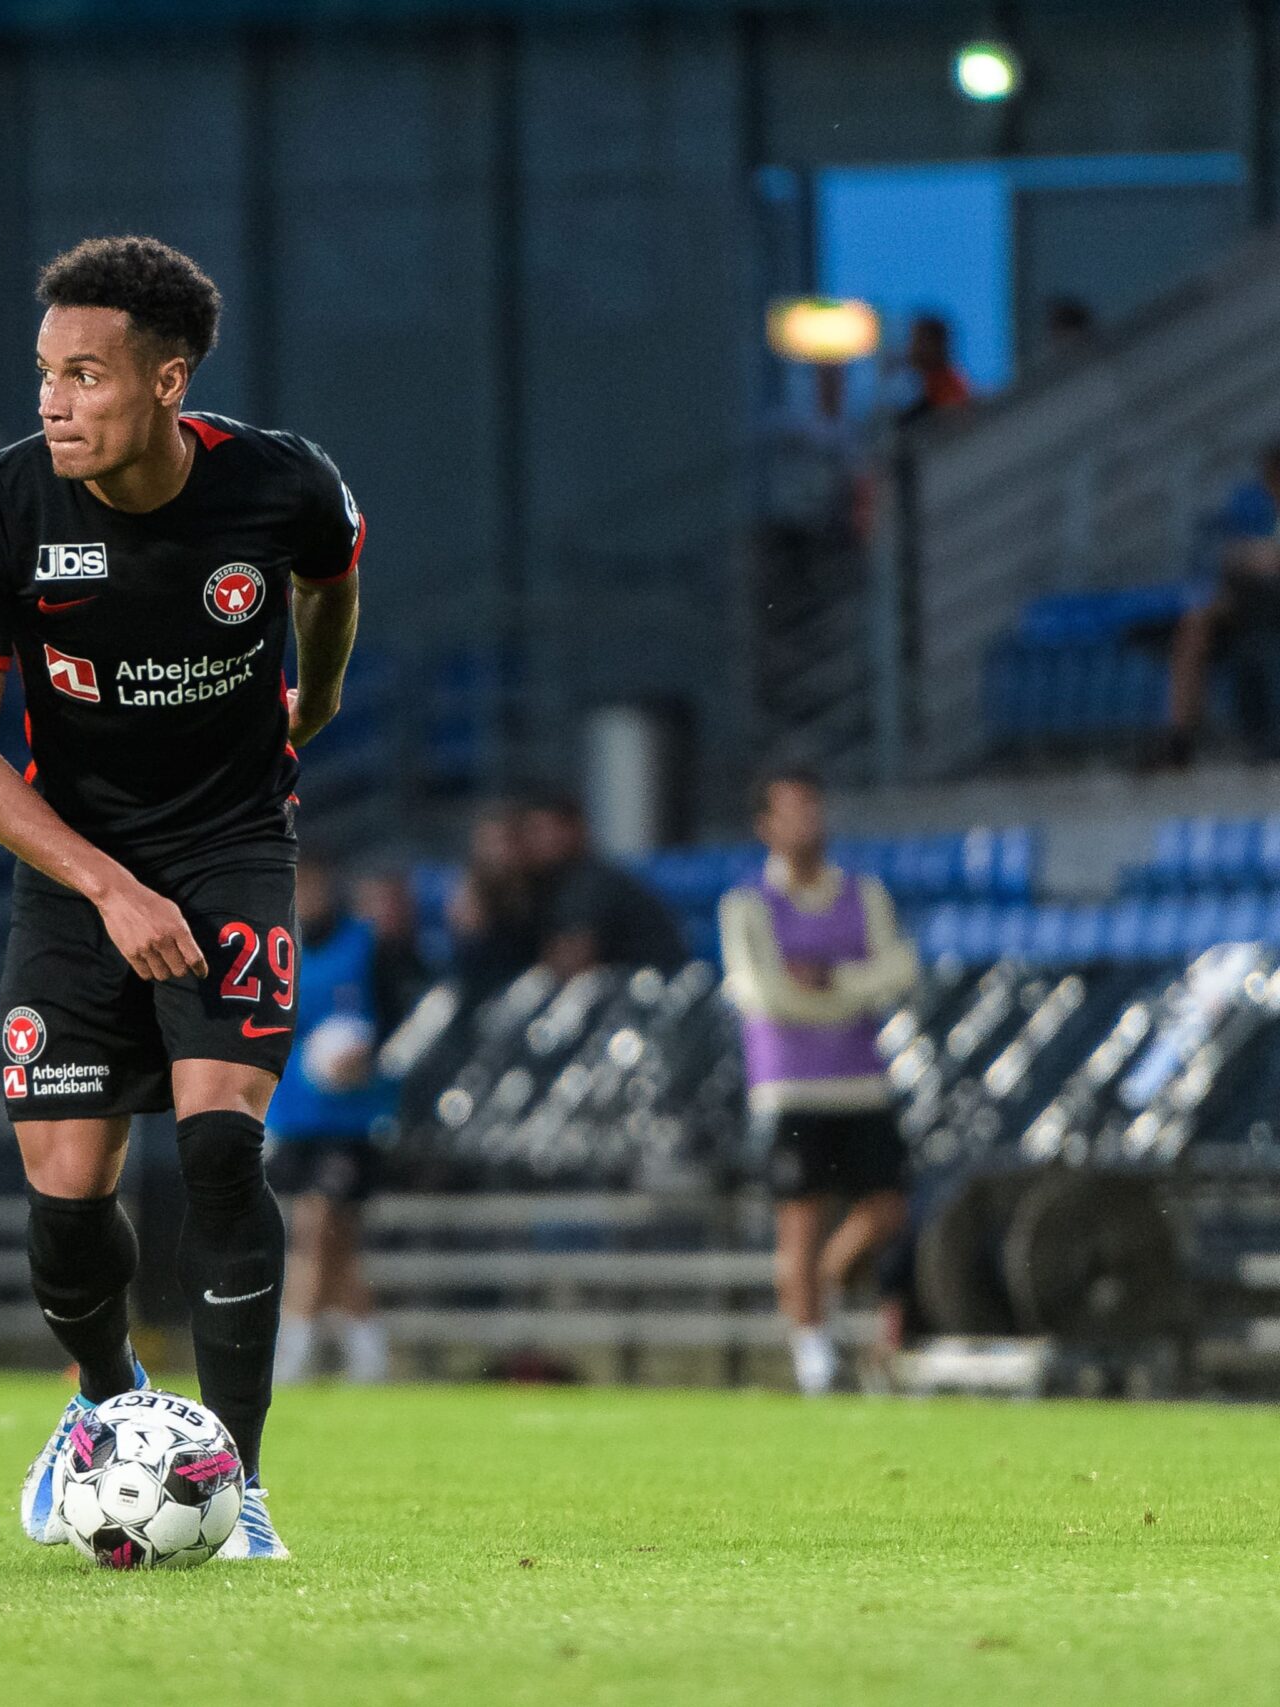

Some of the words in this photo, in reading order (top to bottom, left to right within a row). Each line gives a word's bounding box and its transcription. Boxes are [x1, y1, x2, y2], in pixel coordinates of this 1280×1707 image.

[36, 546, 104, 577] jbs
[214, 566, 262, 587] MIDTJYLLAND
[219, 921, 294, 1010] 29
[32, 1062, 110, 1081] Arbejdernes
[33, 1077, 103, 1095] Landsbank
[109, 1395, 206, 1427] SELECT
